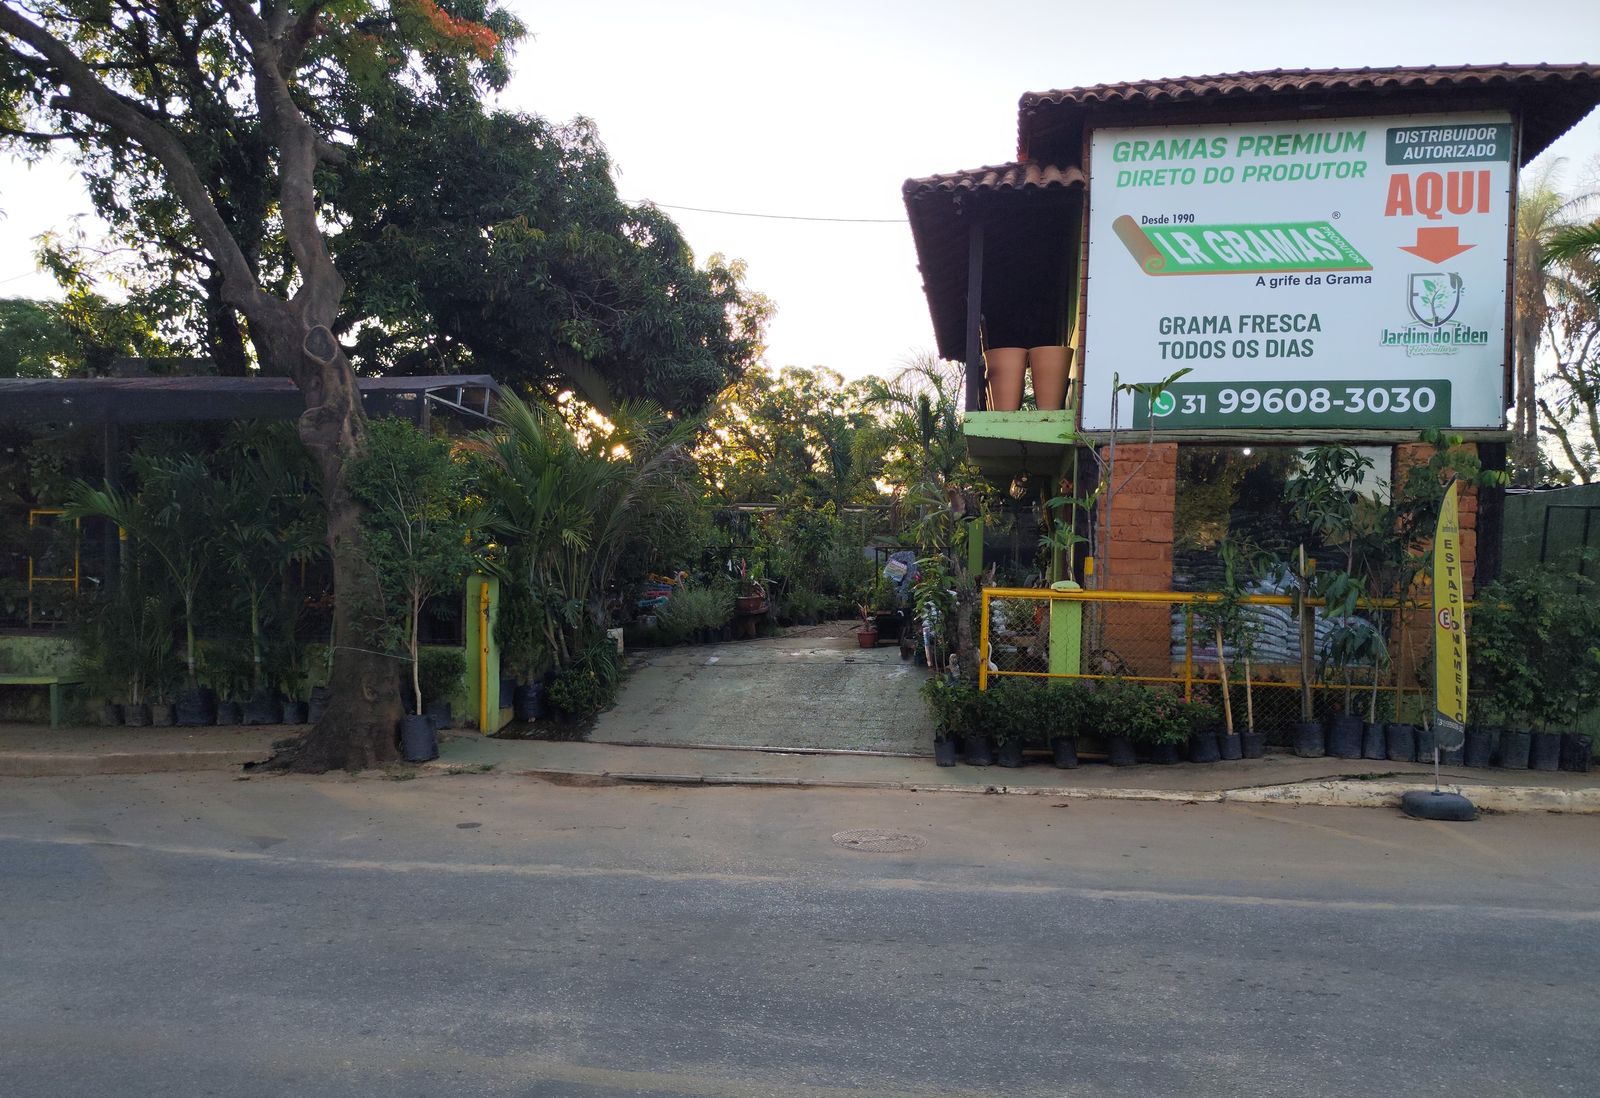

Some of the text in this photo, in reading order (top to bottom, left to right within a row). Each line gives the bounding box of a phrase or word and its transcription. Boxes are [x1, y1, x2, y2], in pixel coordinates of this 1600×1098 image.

[1112, 130, 1367, 163] GRAMAS PREMIUM
[1395, 127, 1498, 144] DISTRIBUIDOR
[1402, 143, 1497, 160] AUTORIZADO
[1116, 160, 1368, 188] DIRETO DO PRODUTOR
[1384, 170, 1491, 220] AQUI
[1141, 213, 1195, 225] Desde 1990
[1152, 227, 1344, 265] LR GRAMAS
[1319, 225, 1364, 264] PRODUTOR
[1255, 273, 1372, 289] A grife da Grama
[1159, 313, 1322, 335] GRAMA FRESCA
[1382, 323, 1489, 345] Jardim do Éden
[1158, 338, 1315, 360] TODOS OS DIAS
[1181, 386, 1437, 414] 31 99608-3030
[1443, 539, 1464, 724] ESTACIONAMENTO
